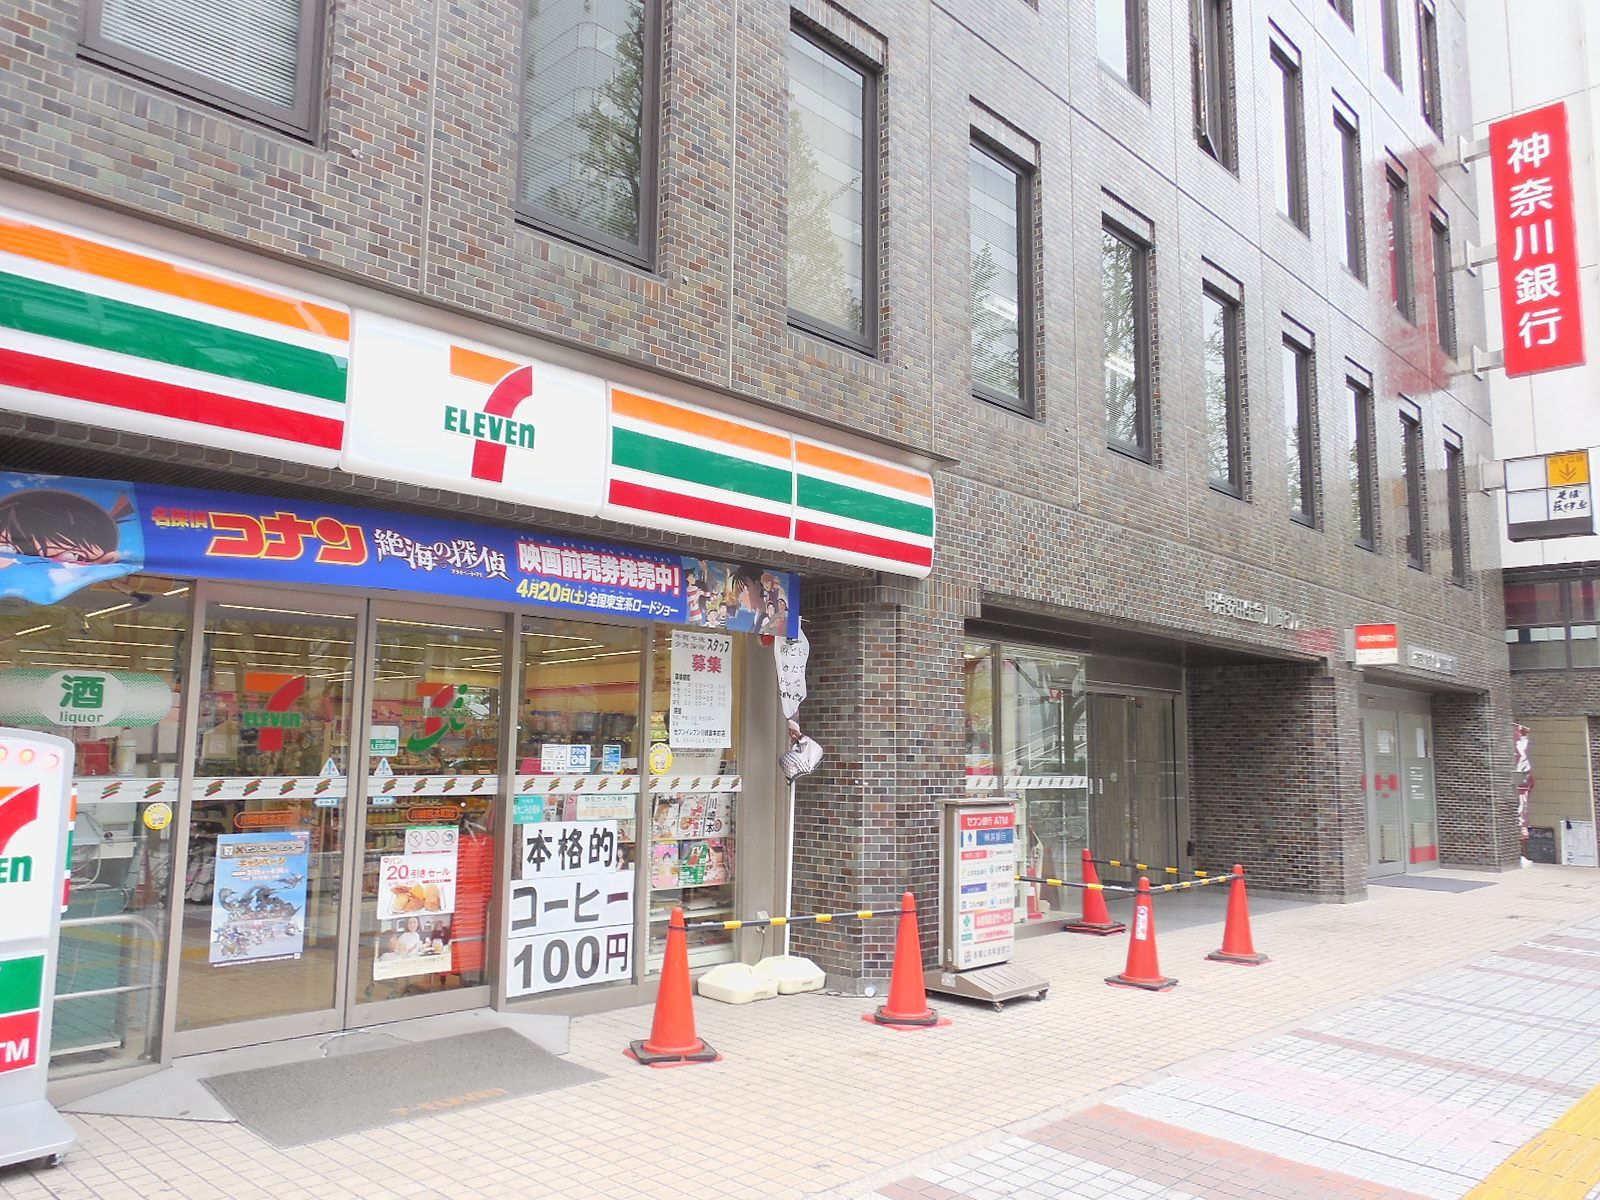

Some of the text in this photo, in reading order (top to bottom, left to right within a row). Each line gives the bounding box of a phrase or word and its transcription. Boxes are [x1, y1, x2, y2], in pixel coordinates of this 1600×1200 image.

[1506, 131, 1564, 350] 神奈川銀行
[205, 510, 369, 567] コナン
[372, 527, 513, 582] 絶海の探偵
[691, 653, 722, 673] 募集
[707, 638, 730, 653] スタッフ
[59, 674, 106, 708] 酒
[60, 711, 104, 723] liquor
[994, 815, 1009, 825] ATM
[526, 827, 614, 872] 本格的
[511, 882, 629, 932] コーヒー
[513, 932, 629, 989] 100円
